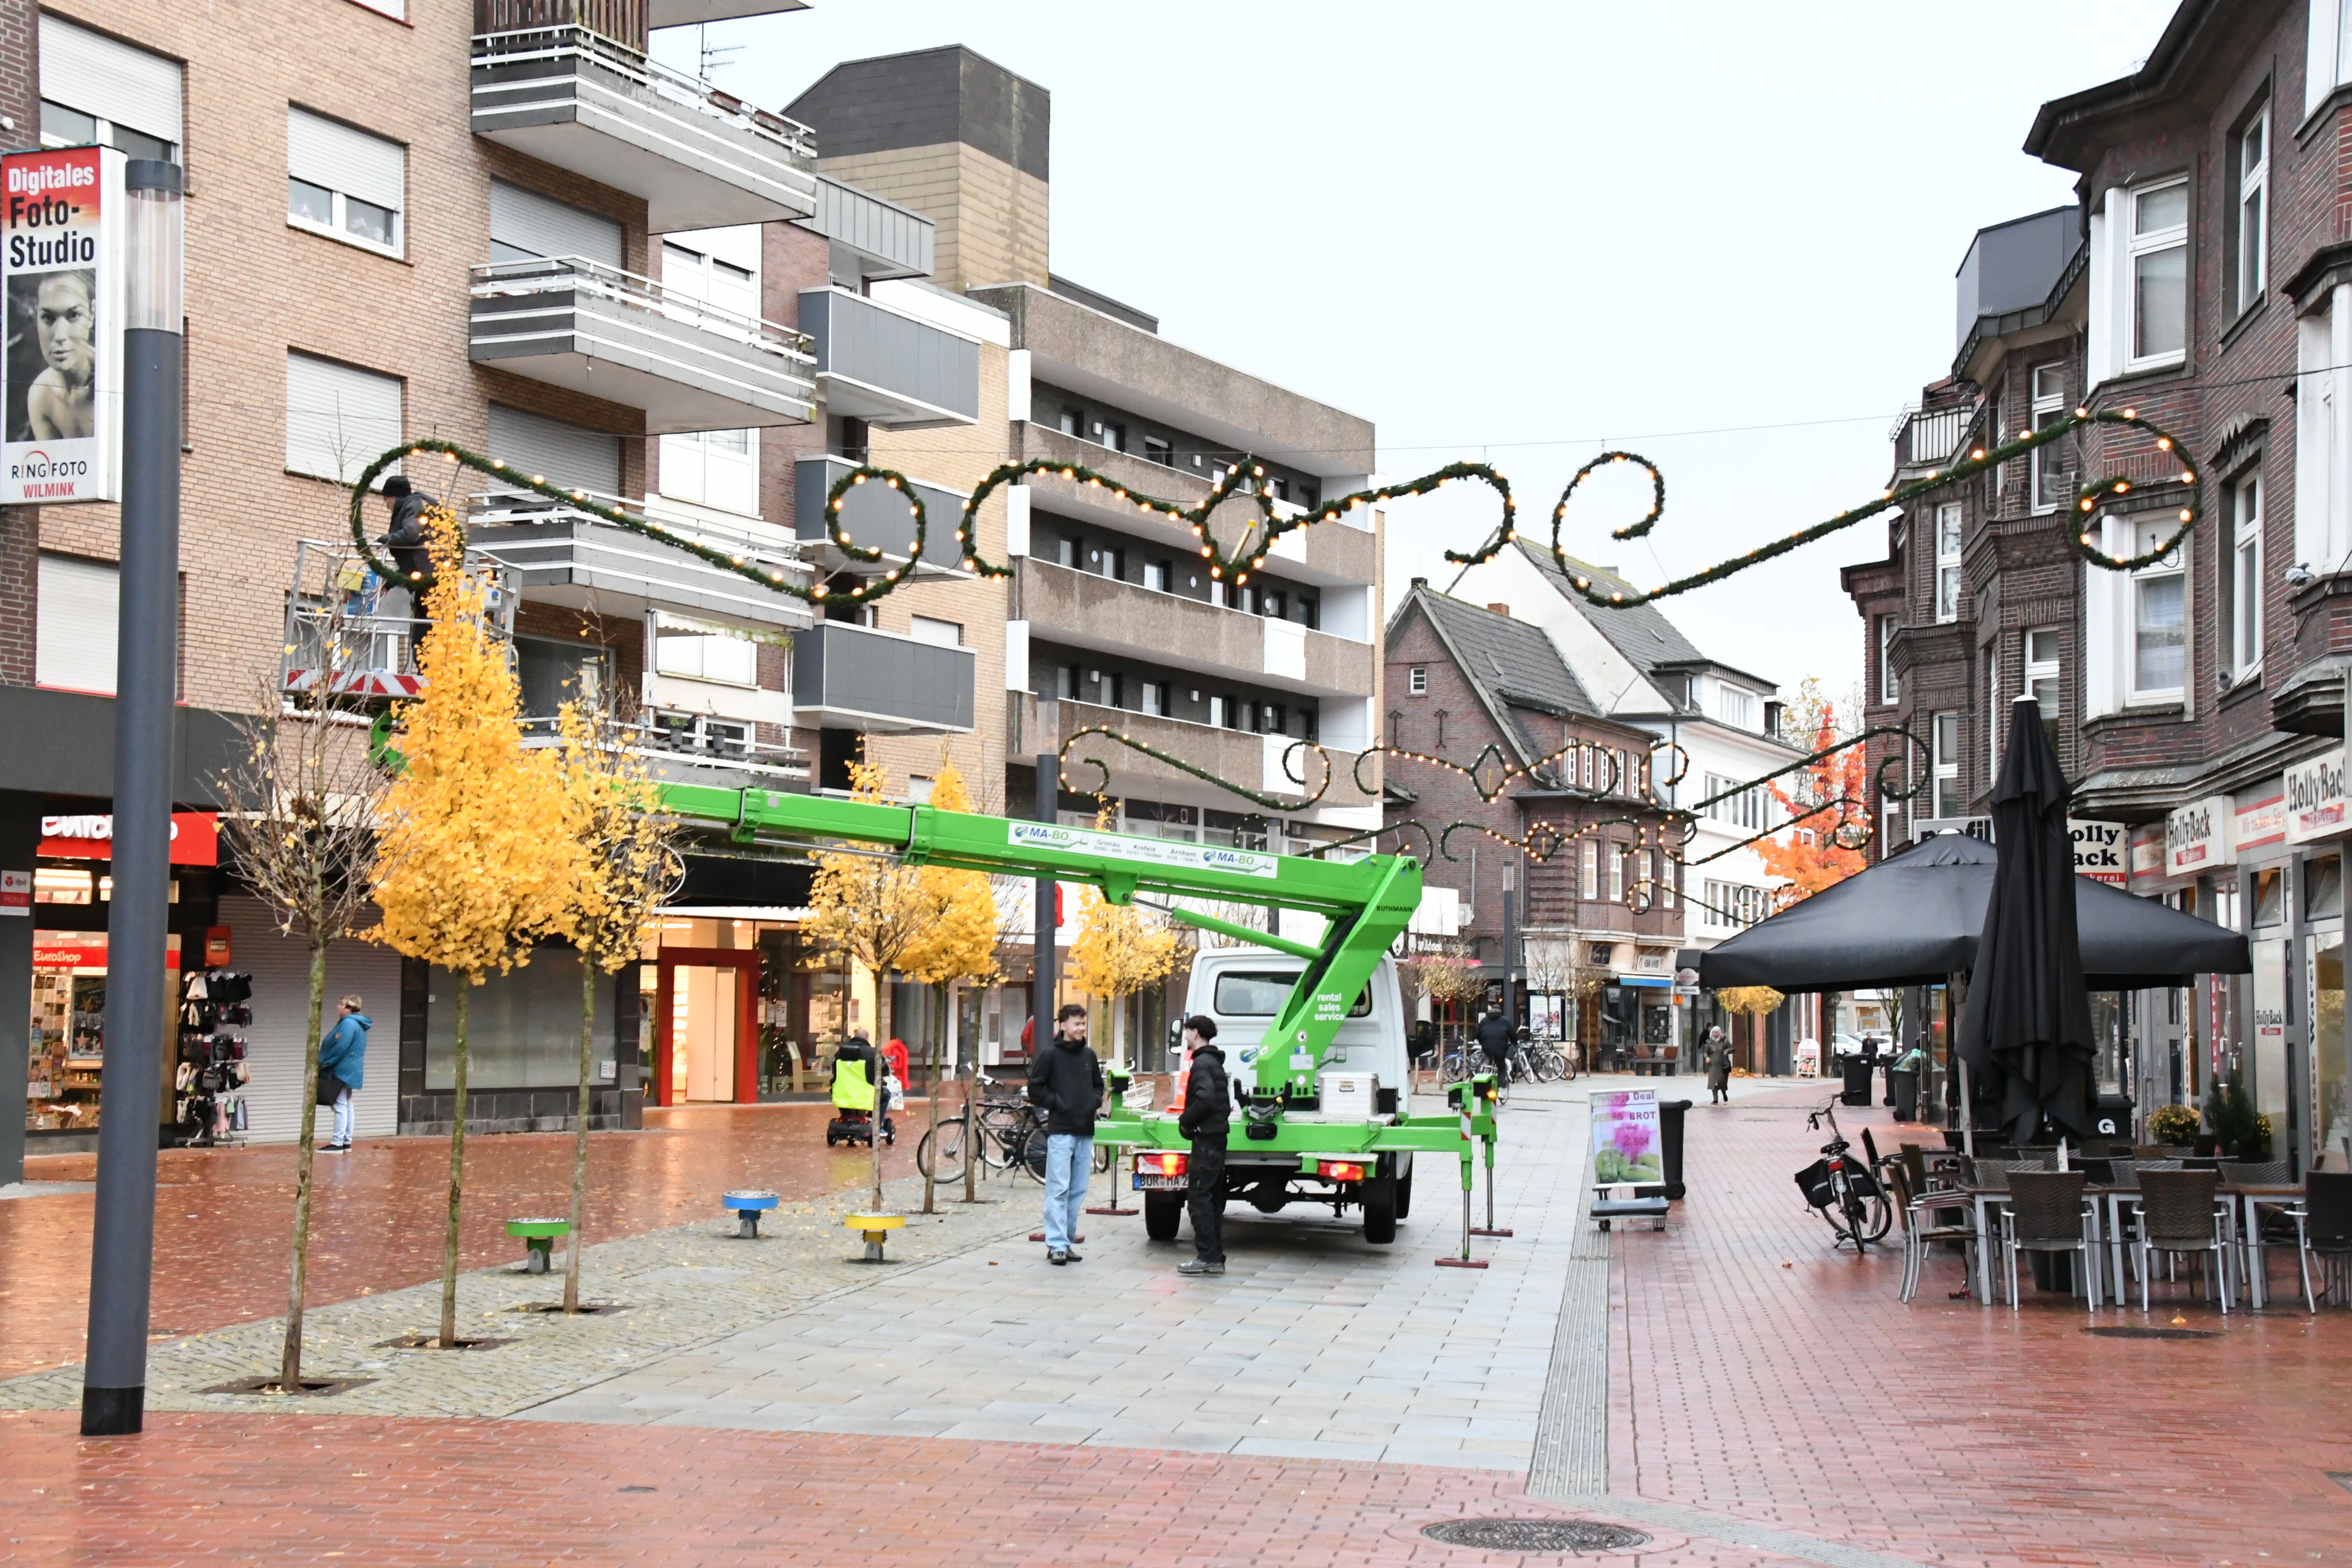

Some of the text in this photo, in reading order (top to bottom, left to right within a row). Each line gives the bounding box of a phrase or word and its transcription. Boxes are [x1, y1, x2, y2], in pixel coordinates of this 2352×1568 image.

[8, 163, 95, 195] Digitales
[11, 195, 79, 229] Foto-
[10, 231, 94, 268] Studio
[23, 482, 75, 498] WILMINK
[1030, 827, 1069, 841] MA-BO
[2069, 825, 2120, 846] olly
[2169, 809, 2211, 852] HollyBack
[1097, 839, 1120, 848] Gronau
[1133, 844, 1156, 853] Krefeld
[1170, 849, 1196, 858] Arnhem
[1217, 852, 1254, 865] MA-BO
[2073, 848, 2119, 866] ack
[34, 950, 81, 965] EuroShop
[1317, 993, 1342, 1001] rental
[1318, 1003, 1340, 1012] sales
[1314, 1012, 1345, 1021] service
[2256, 1009, 2283, 1028] HollyBack
[1633, 1091, 1654, 1101] Deal
[1629, 1111, 1656, 1120] BROT
[1140, 1175, 1188, 1187] BOR MA 2
